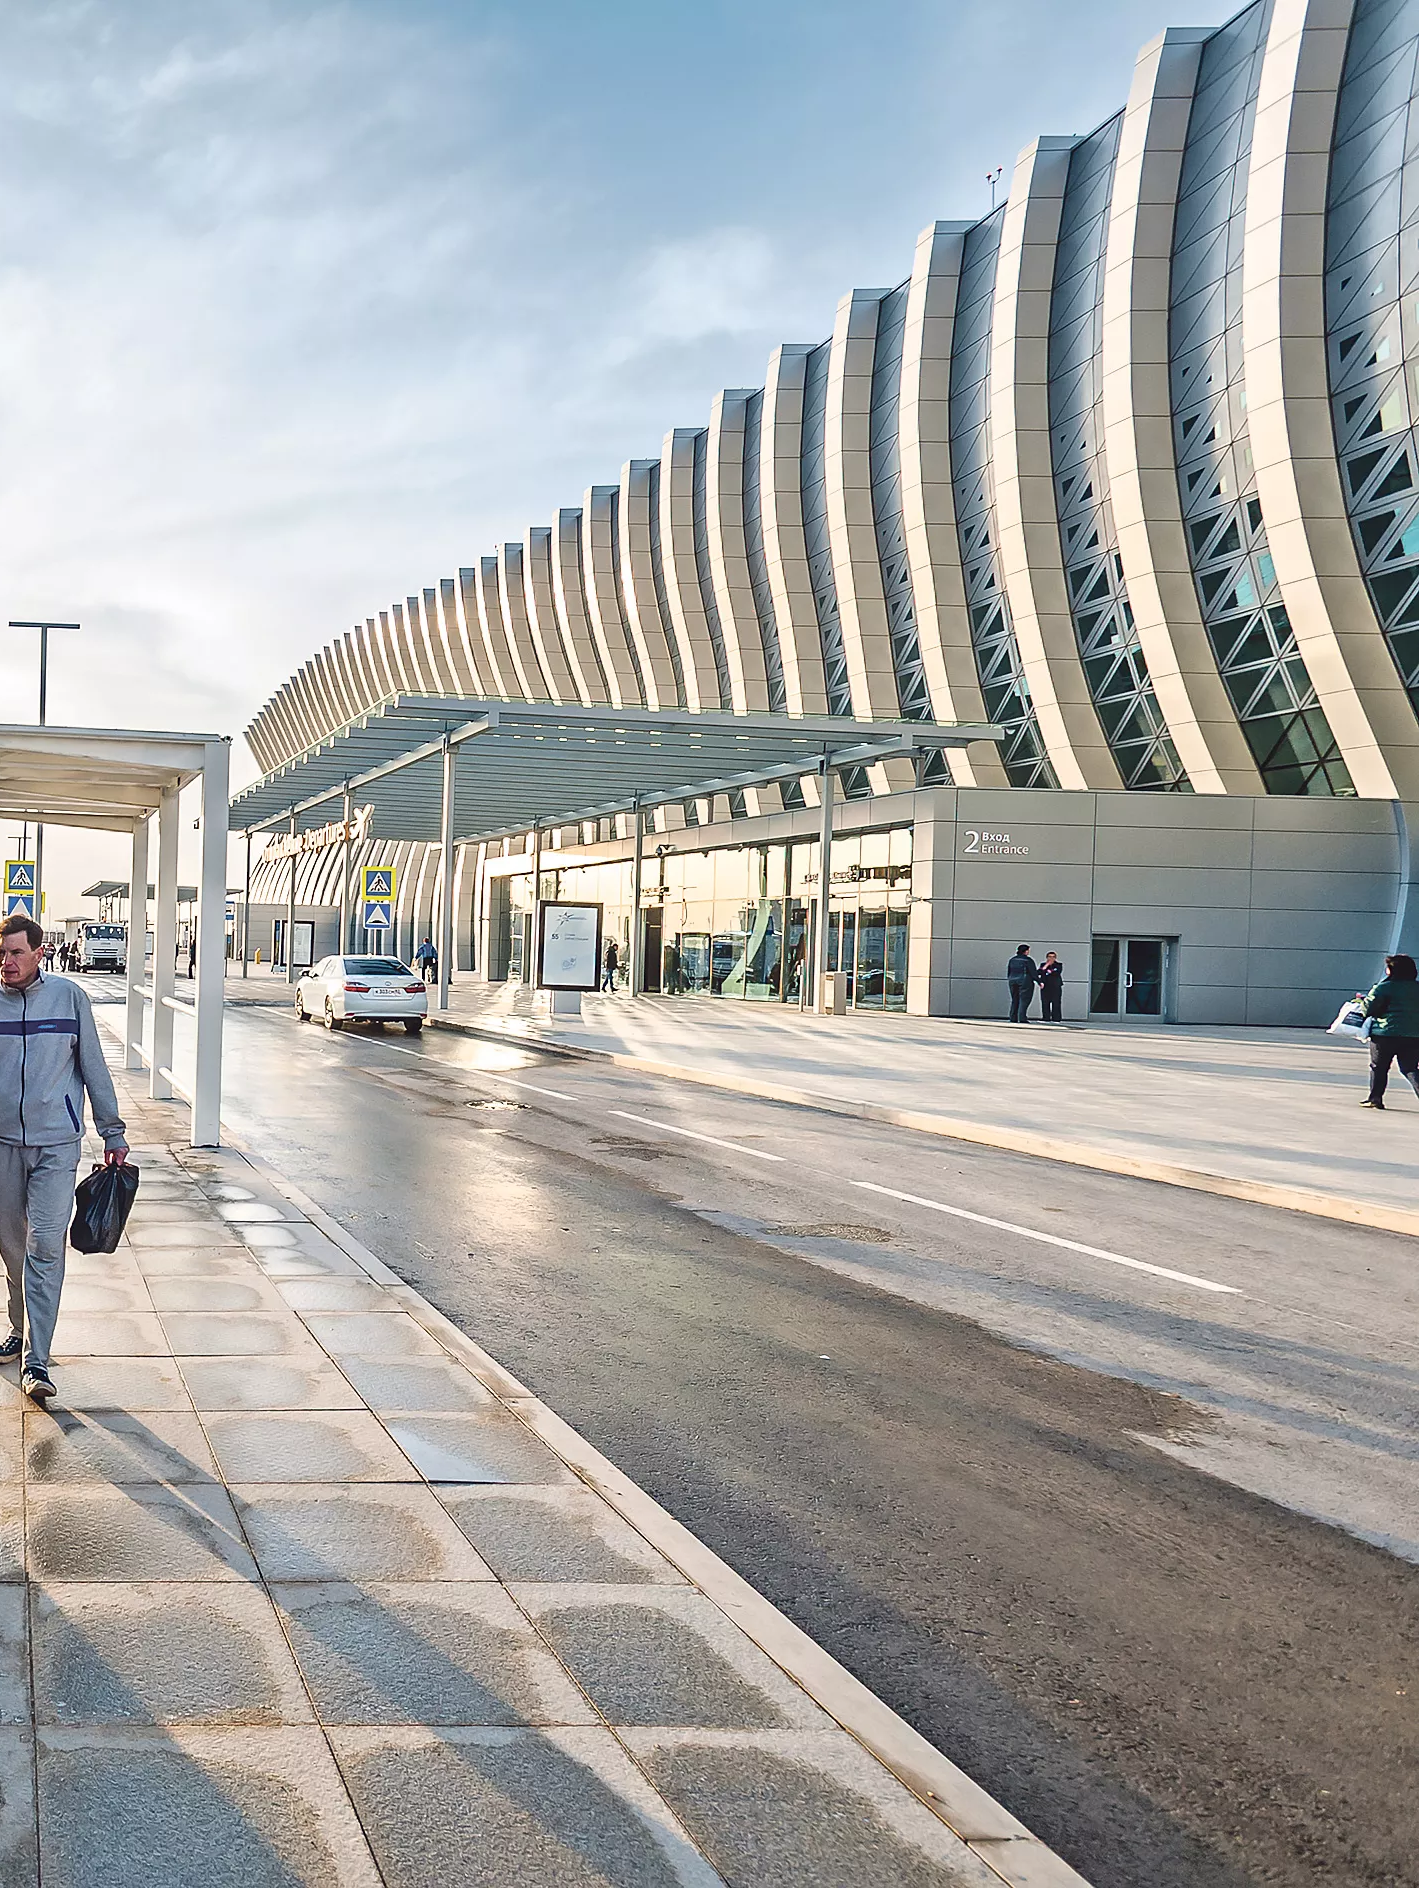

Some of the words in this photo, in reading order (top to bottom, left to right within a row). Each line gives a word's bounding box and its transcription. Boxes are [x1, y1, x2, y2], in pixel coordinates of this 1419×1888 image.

[964, 830, 980, 854] 2
[982, 831, 1011, 844] Вход
[981, 844, 1029, 855] Entrance
